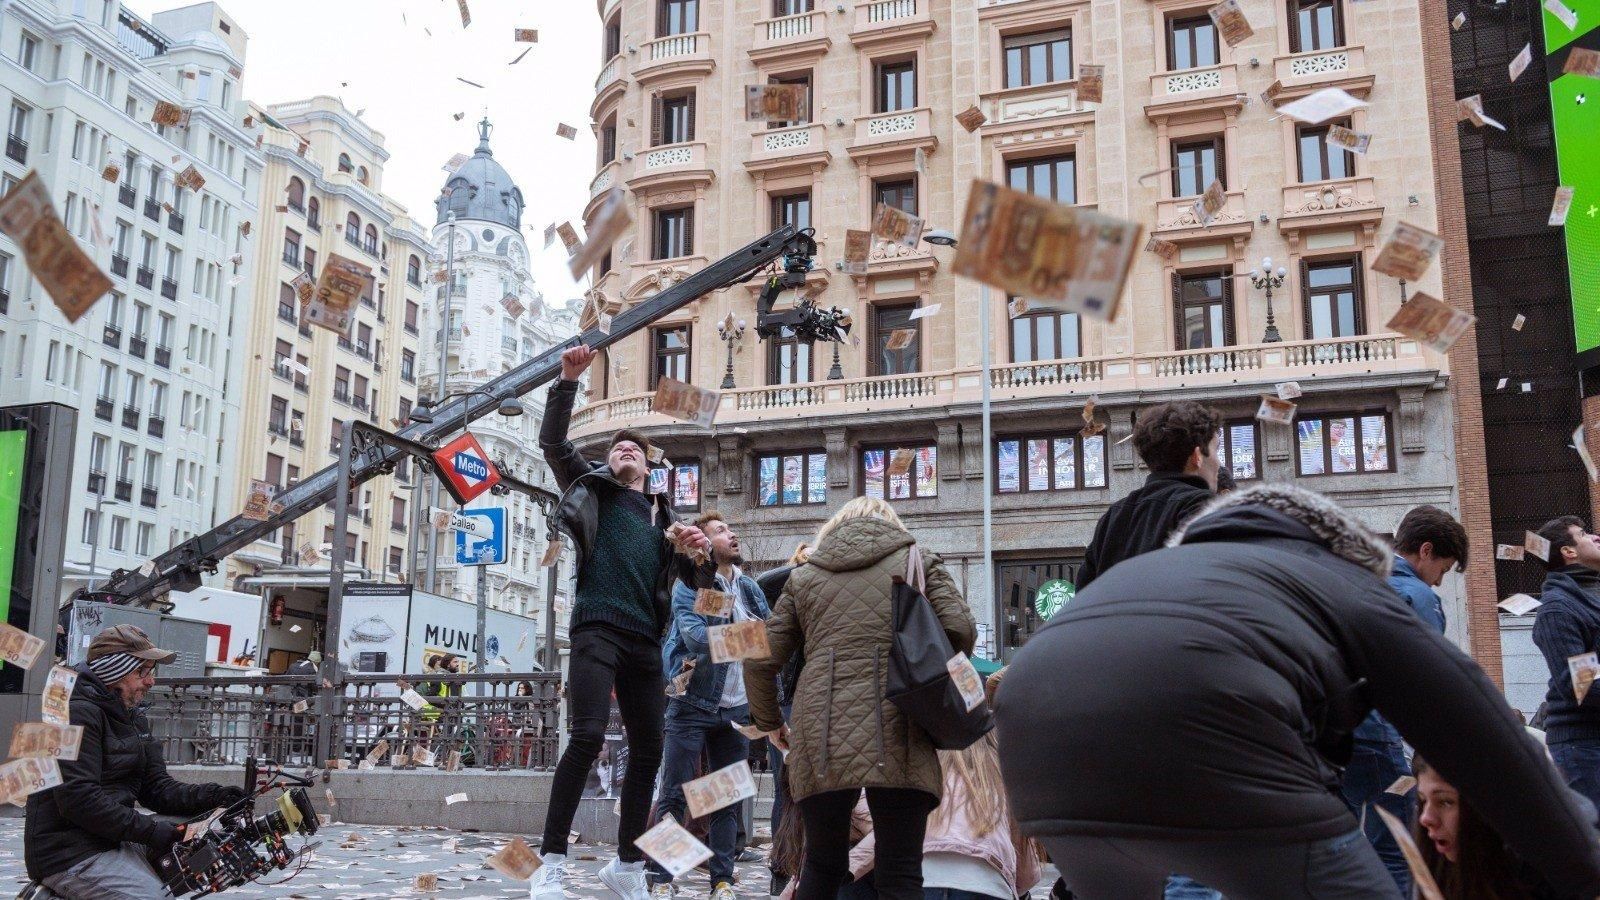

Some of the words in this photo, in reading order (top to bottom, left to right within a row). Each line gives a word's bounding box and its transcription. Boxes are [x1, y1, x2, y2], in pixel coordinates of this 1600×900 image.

[686, 410, 699, 421] 50
[458, 455, 486, 477] Metro
[451, 515, 476, 531] Callao
[5, 650, 19, 661] 50
[47, 747, 61, 756] 50
[32, 778, 46, 790] 50
[726, 789, 741, 801] 50
